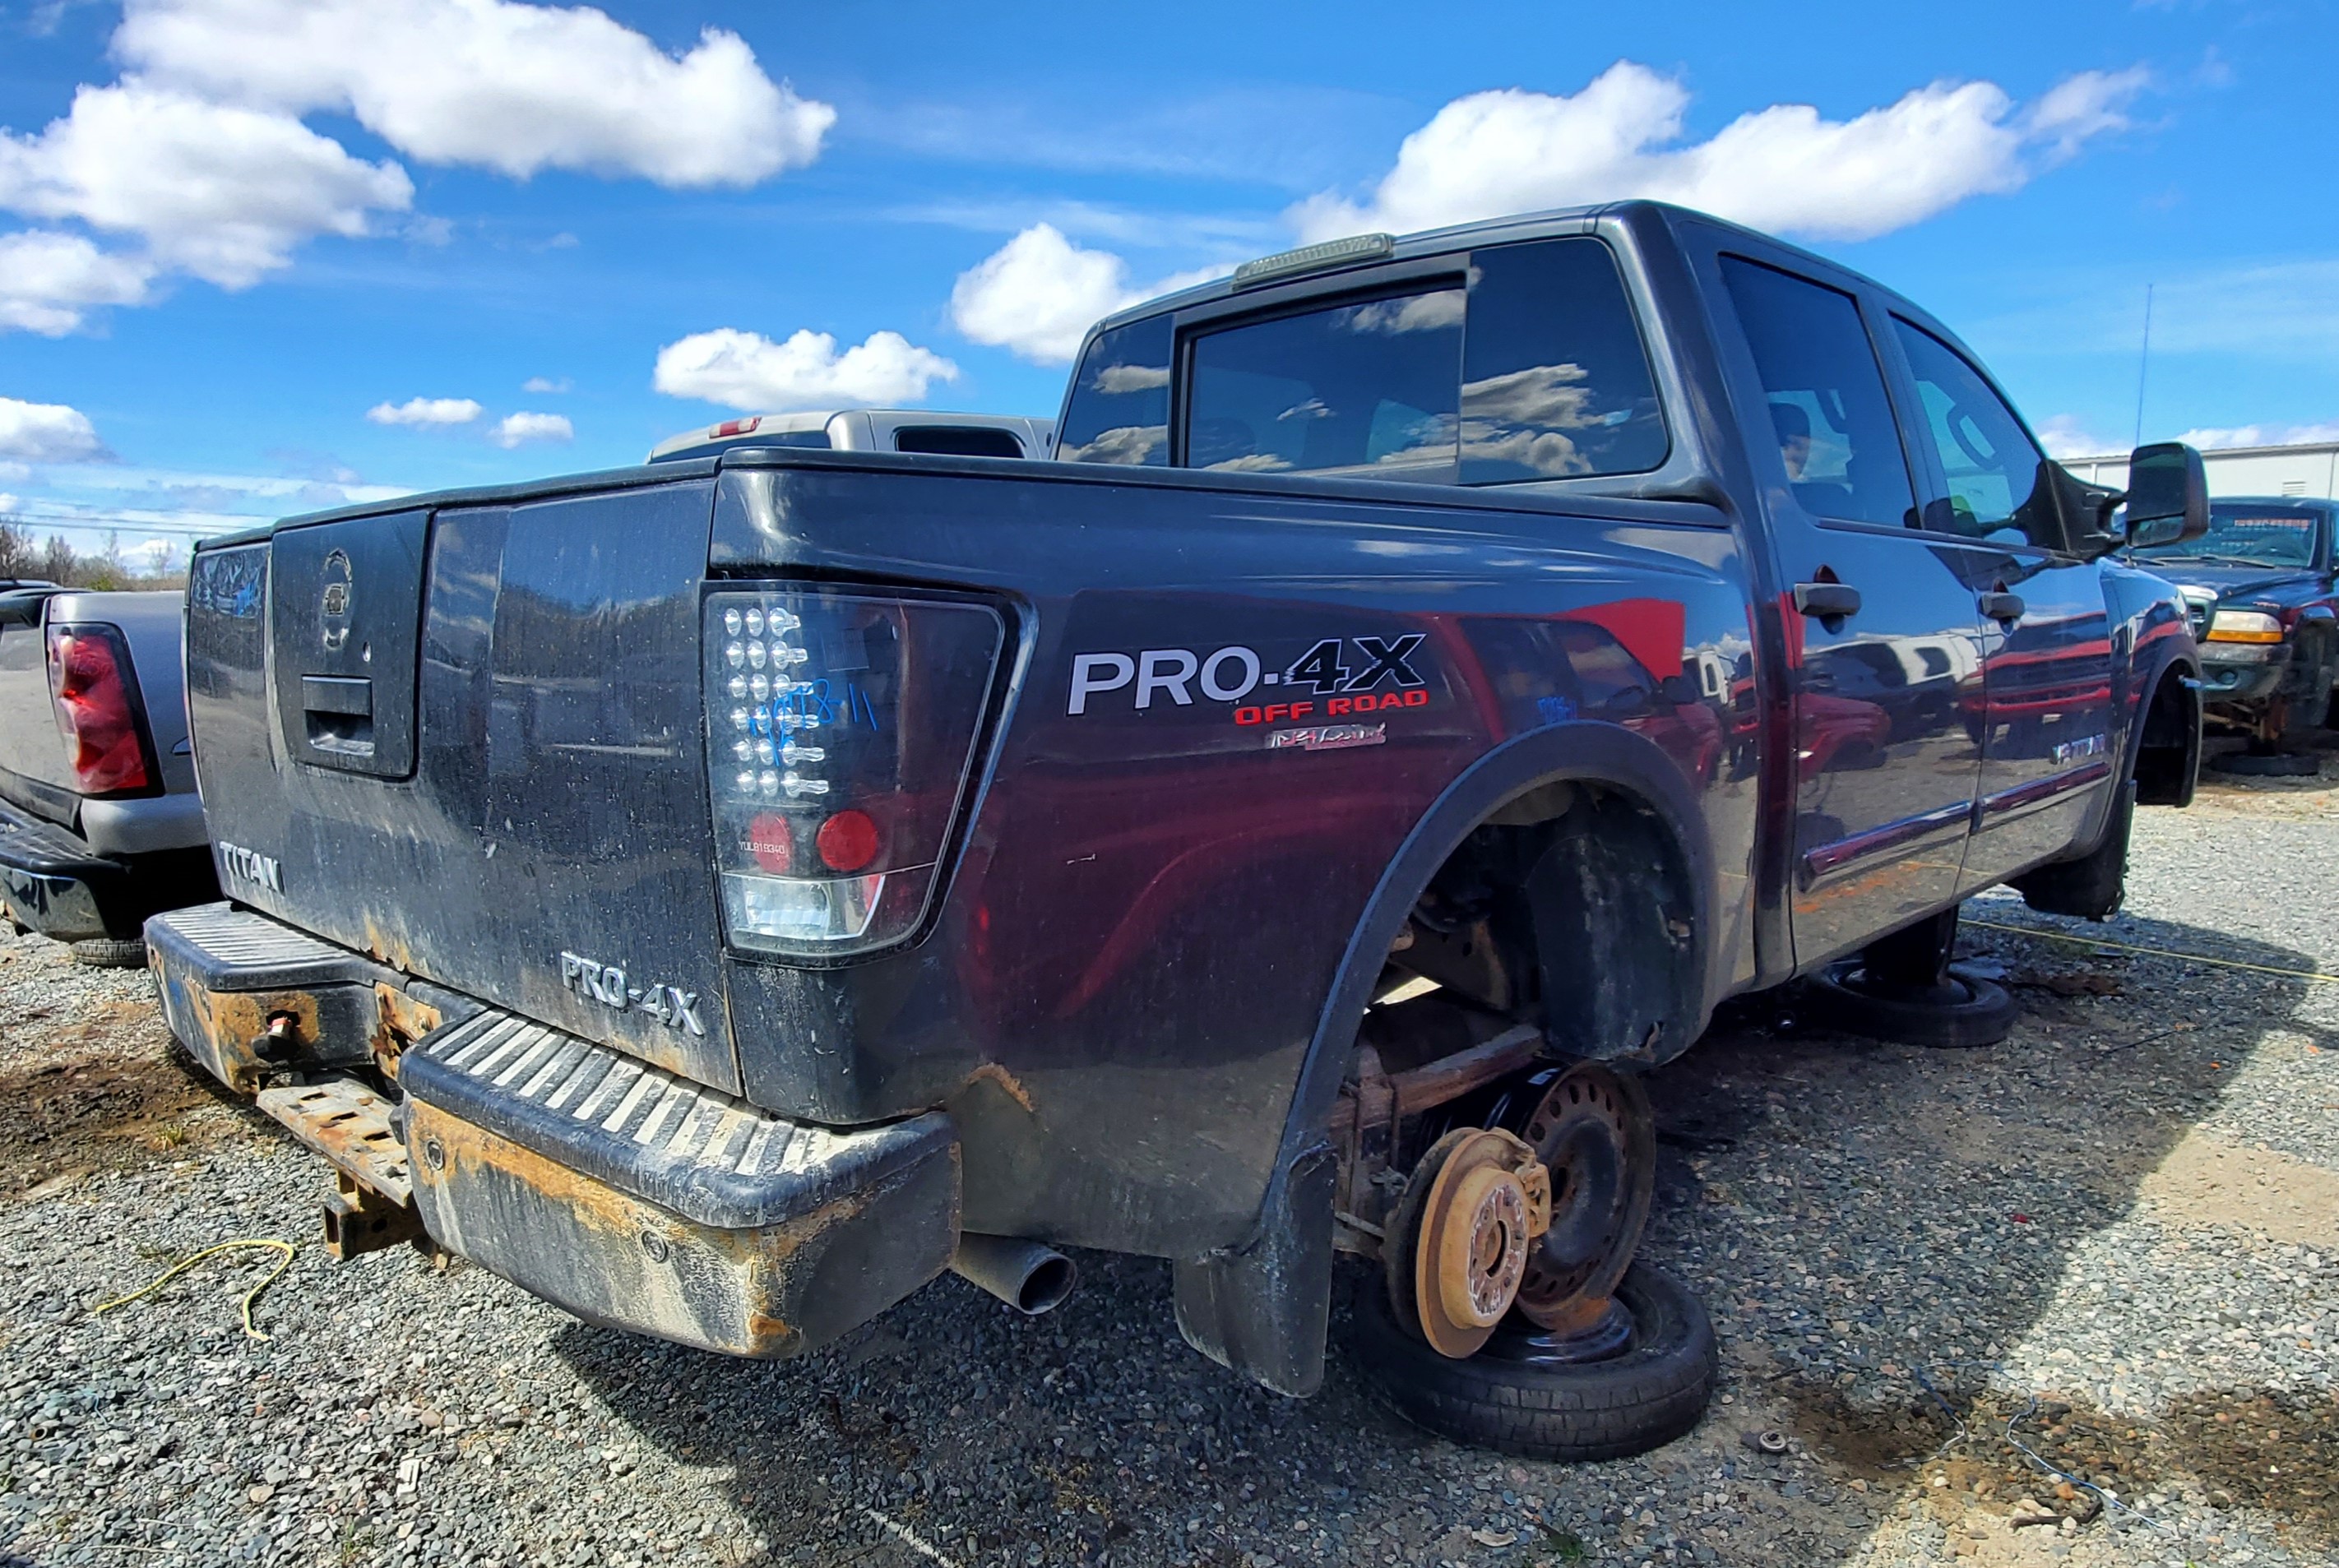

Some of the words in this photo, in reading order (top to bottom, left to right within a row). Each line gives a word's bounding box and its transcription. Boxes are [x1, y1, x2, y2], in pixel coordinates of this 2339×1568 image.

[1234, 704, 1313, 725] OFF
[1328, 689, 1429, 715] ROAD
[220, 840, 285, 895] TITAN
[560, 951, 705, 1037] PRO-4X
